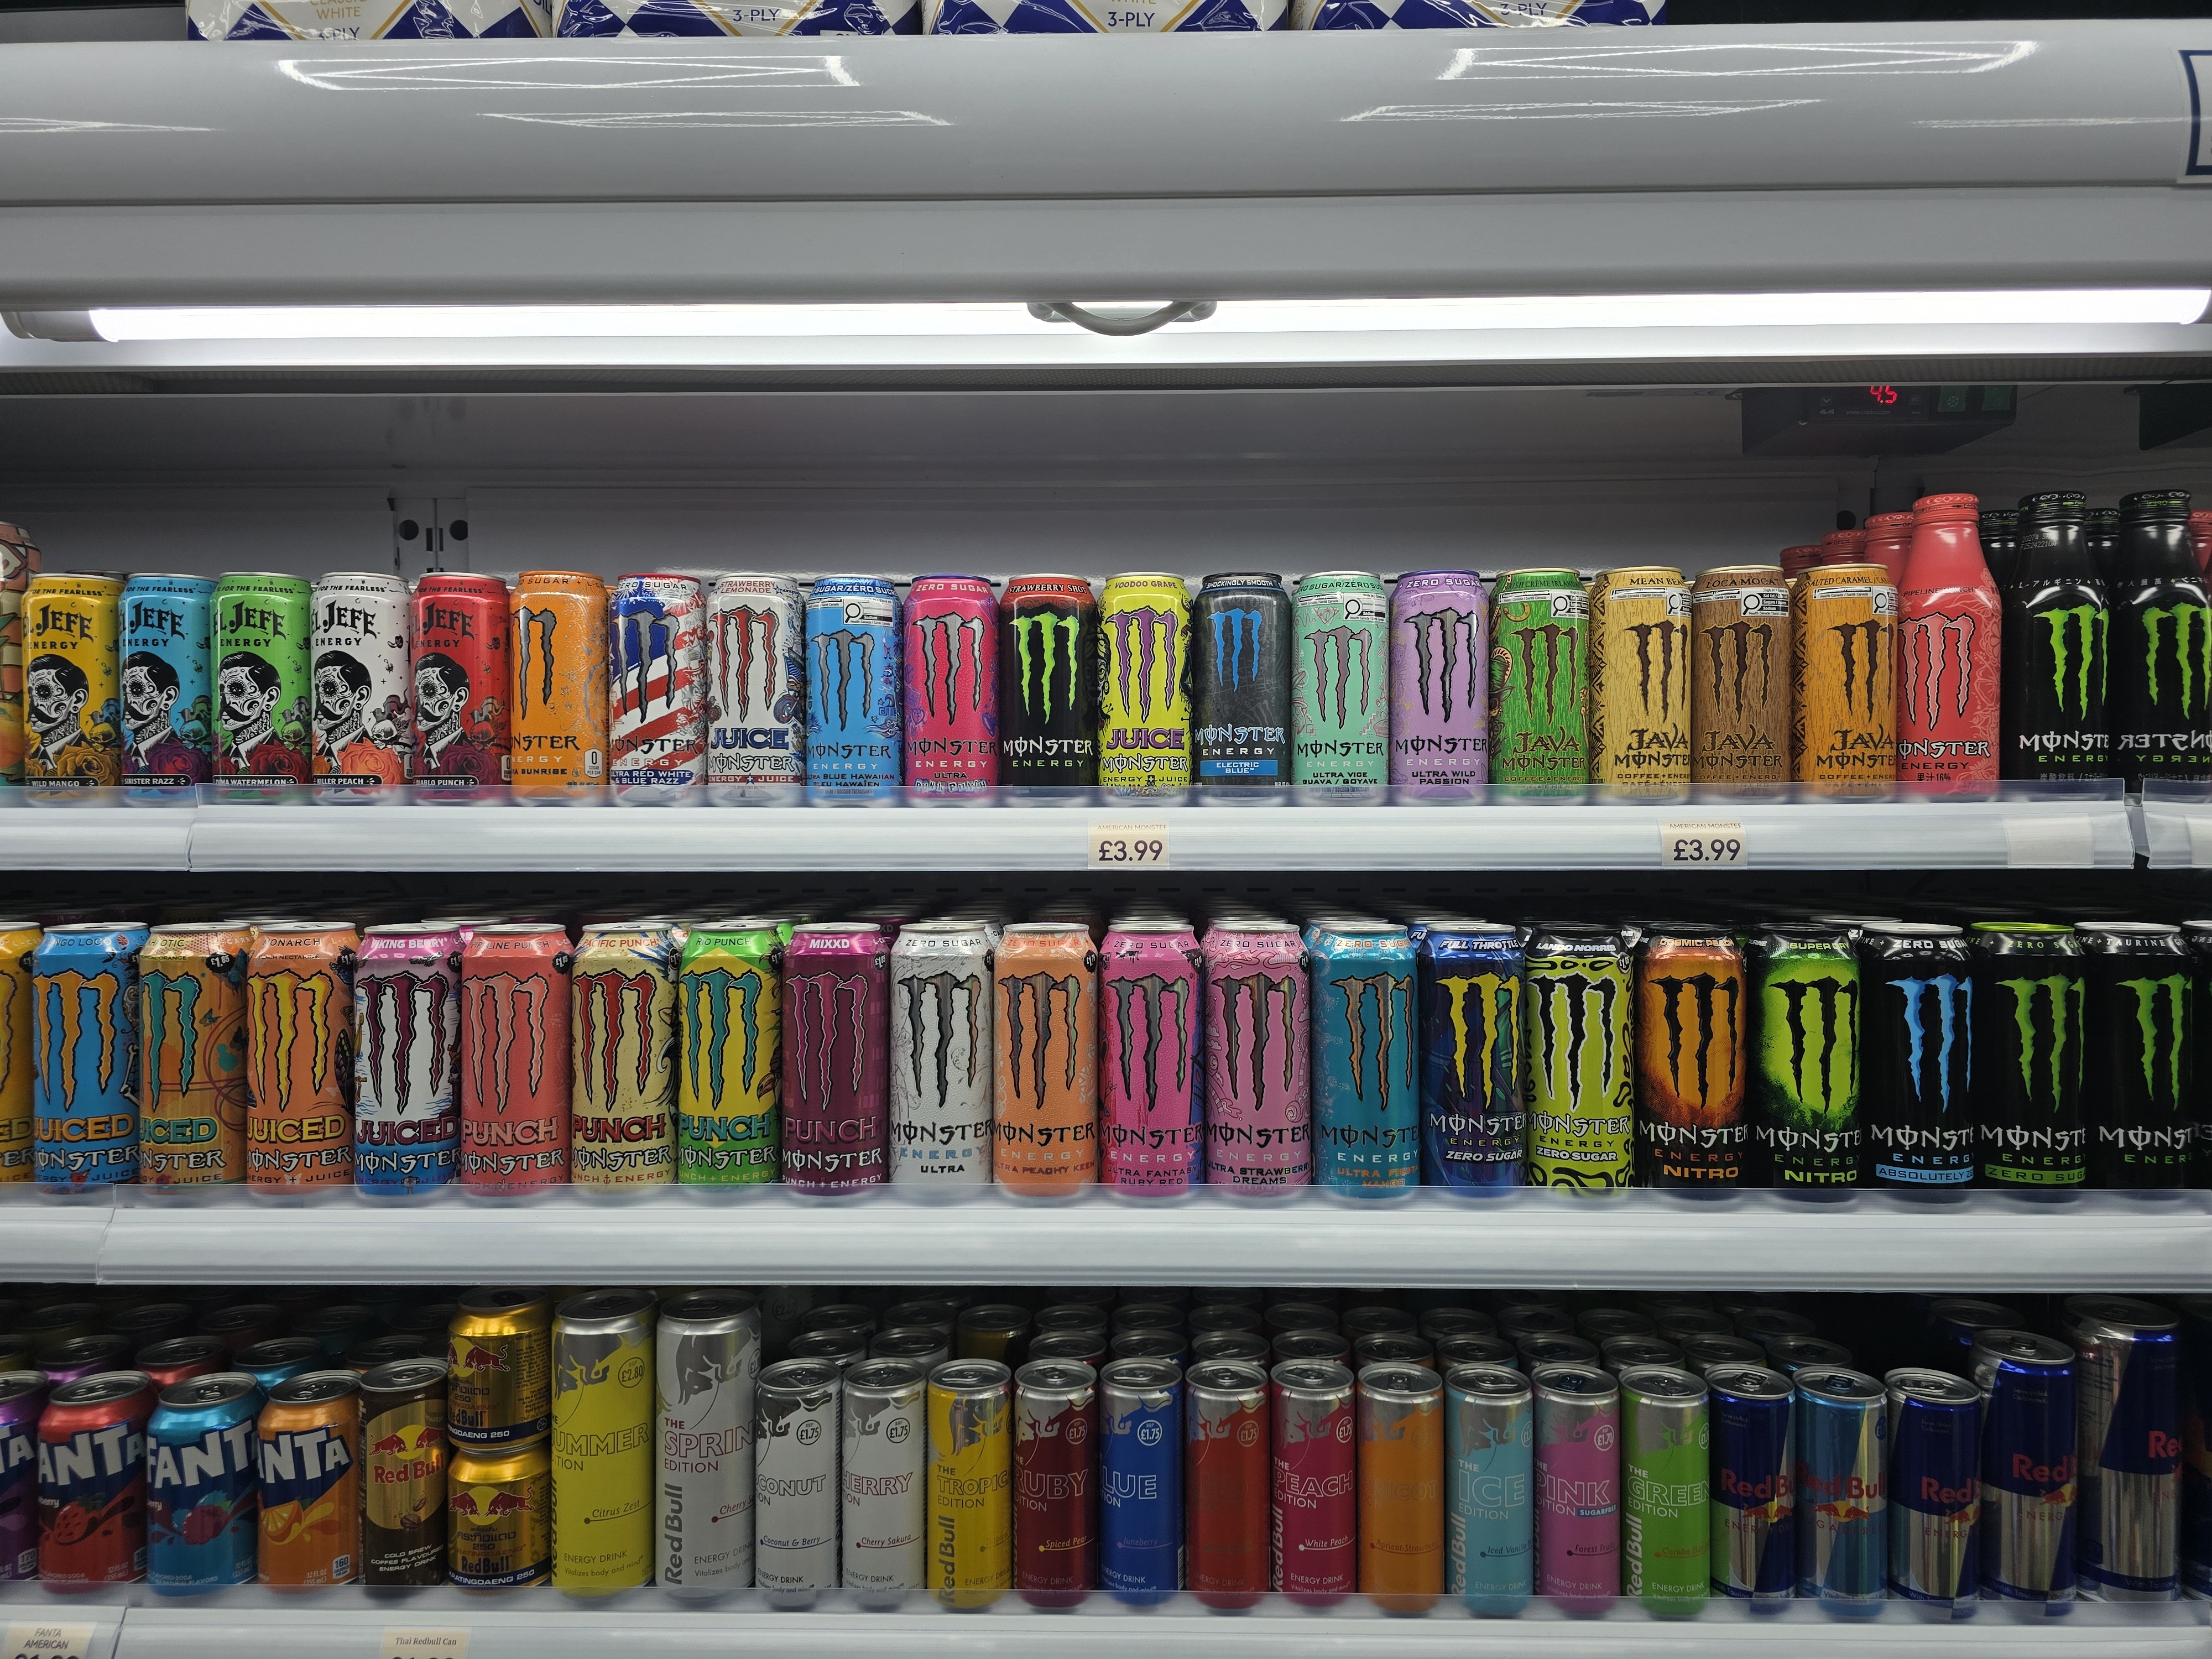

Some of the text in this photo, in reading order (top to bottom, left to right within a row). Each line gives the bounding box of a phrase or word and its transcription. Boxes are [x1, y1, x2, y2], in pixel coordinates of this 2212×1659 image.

[1108, 12, 1155, 27] 3-PLY
[645, 582, 687, 590] SUGAR
[916, 583, 988, 593] ZERO SUGAR
[1009, 583, 1087, 594] STRAWBERRY SHOT
[1151, 581, 1177, 589] GRAPE
[1406, 579, 1445, 588] ZERO
[711, 728, 789, 749] JUICE
[1107, 728, 1184, 749] JUICE
[1099, 840, 1163, 861] £3.99
[1673, 839, 1741, 860] £3.99
[409, 938, 445, 949] BERRY
[583, 938, 658, 947] PACIFIC PUNCH
[810, 938, 850, 949] MIXXD
[943, 938, 982, 947] SUGAR
[1151, 941, 1190, 949] SUGAR
[1256, 940, 1296, 948] SUGAR
[1439, 939, 1519, 950] FULL THROTTLE
[1536, 942, 1616, 952] LANDO NORRIS
[1659, 938, 1702, 947] COSMIC
[1790, 942, 1832, 951] SUPER
[1893, 940, 1934, 950] ZERO
[2007, 940, 2044, 949] ZERO
[2106, 938, 2166, 947] TAURINE
[211, 954, 230, 967] £1.85
[357, 1115, 458, 1145] JUICED
[462, 1116, 559, 1146] PUNCH
[573, 1113, 666, 1142] PUNCH
[1446, 1149, 1524, 1161] ZERO SUGAR
[1536, 1147, 1618, 1161] ZERO SUGAR
[921, 1165, 964, 1173] ULTRA
[1663, 1165, 1739, 1179] NITRO
[1989, 1167, 2043, 1181] ZERO
[1233, 1176, 1287, 1185] DREAMS
[1785, 1170, 1857, 1183] NITRO
[620, 1366, 644, 1383] £2.80
[664, 1417, 685, 1430] THE
[489, 1430, 510, 1438] 250
[800, 1426, 820, 1440] £1.75
[890, 1423, 909, 1437] £1.75
[1070, 1427, 1086, 1439] £1.75
[1141, 1426, 1160, 1440] £1.75
[1598, 1433, 1614, 1446] £1.70
[665, 1460, 719, 1473] EDITION
[1275, 1457, 1290, 1470] THE
[1459, 1459, 1479, 1472] THE
[374, 1464, 410, 1484] Red
[937, 1464, 956, 1476] THE
[1628, 1464, 1648, 1478] THE
[1274, 1467, 1353, 1498] PEACH
[938, 1497, 984, 1508] EDITION
[592, 1500, 640, 1519] Citrus Zest
[1459, 1503, 1508, 1520] EDITION
[1628, 1498, 1678, 1519] EDITION
[764, 1536, 790, 1546] Coconut
[802, 1536, 820, 1546] Berry
[862, 1534, 911, 1546] Cherry Sakura
[1046, 1538, 1071, 1548] Spiced
[1123, 1537, 1158, 1547] Juneberry
[1305, 1536, 1348, 1547] White Peach
[409, 1545, 432, 1556] BREW
[1575, 1545, 1598, 1553] Forest
[564, 1550, 628, 1564] ENERGY DRINK
[516, 1568, 535, 1579] 250
[870, 1574, 894, 1583] DRINK
[1123, 1574, 1146, 1583] DRINK
[1323, 1574, 1344, 1584] DRINK
[35, 1628, 62, 1637] FANTA
[24, 1639, 69, 1649] AMERICAN
